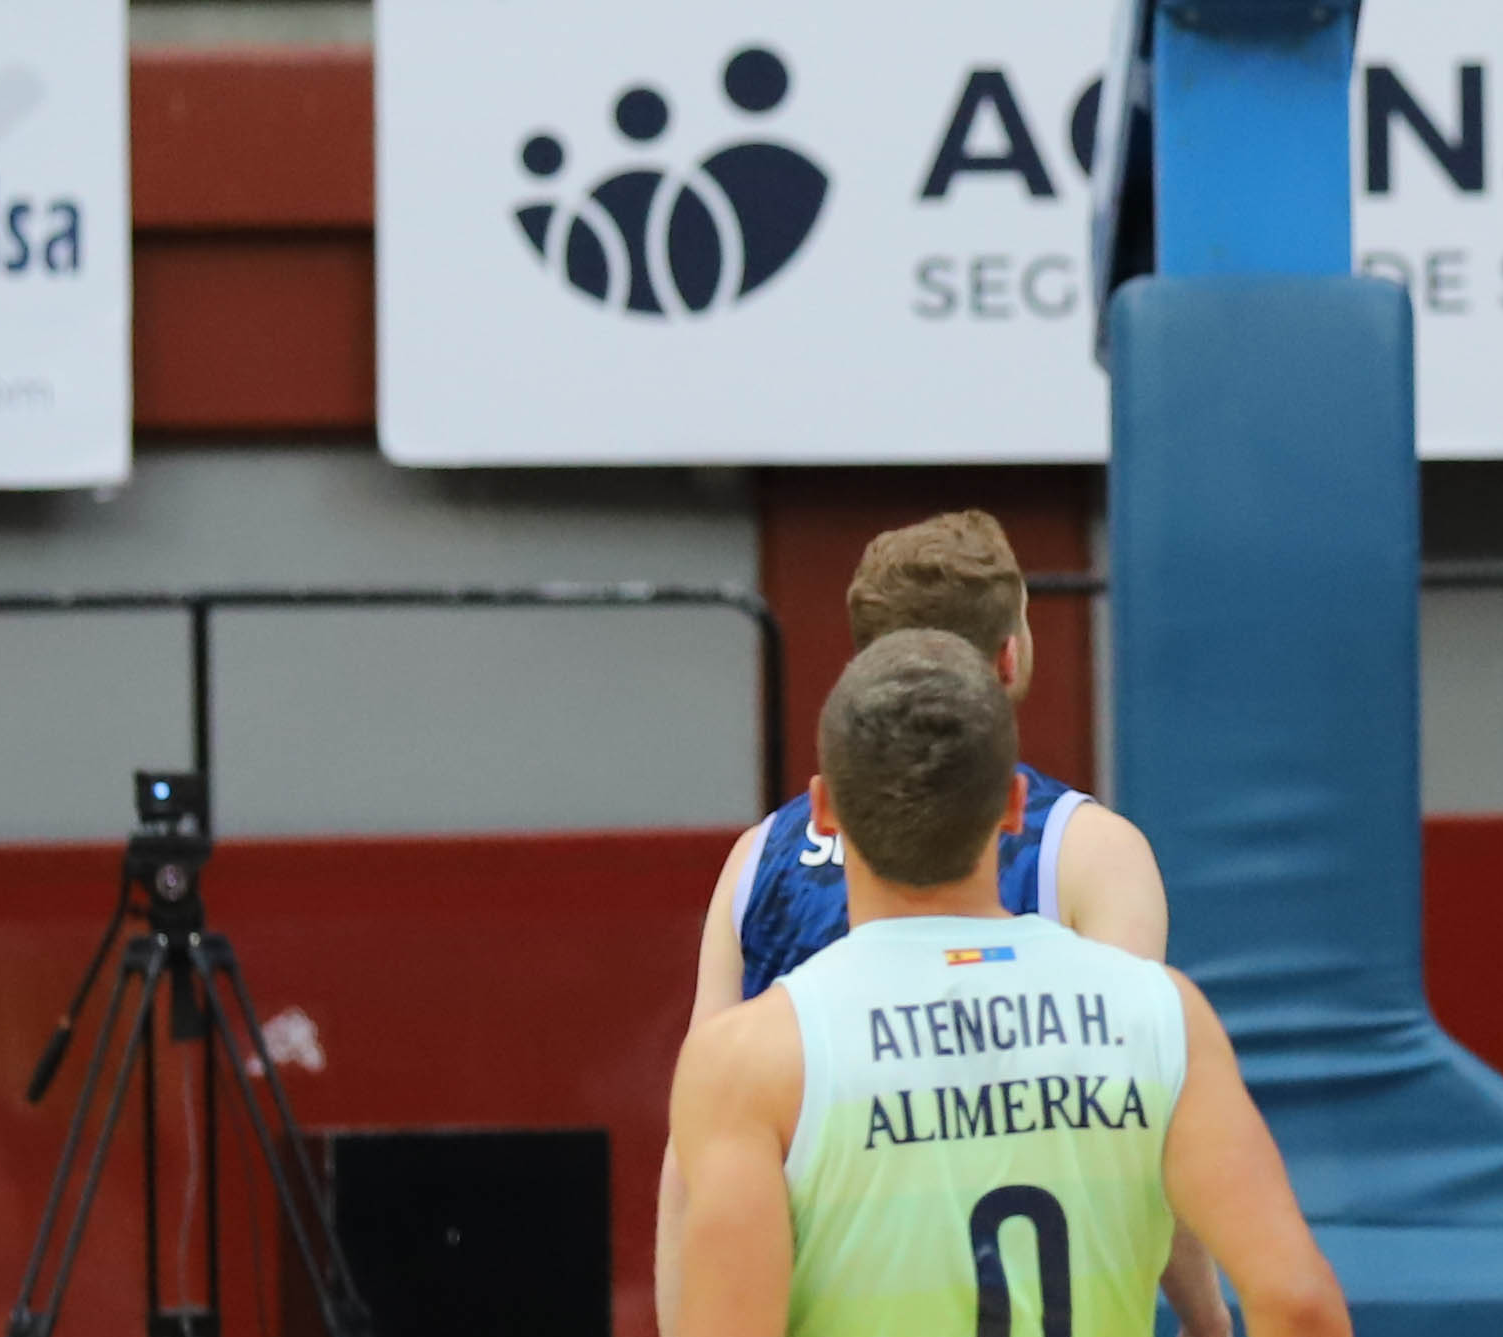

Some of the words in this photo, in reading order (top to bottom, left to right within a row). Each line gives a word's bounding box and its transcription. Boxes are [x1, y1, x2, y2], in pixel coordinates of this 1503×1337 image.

[870, 994, 1066, 1061] ATENCIA
[1077, 996, 1125, 1049] H.
[863, 1075, 1150, 1151] ALIMERKA
